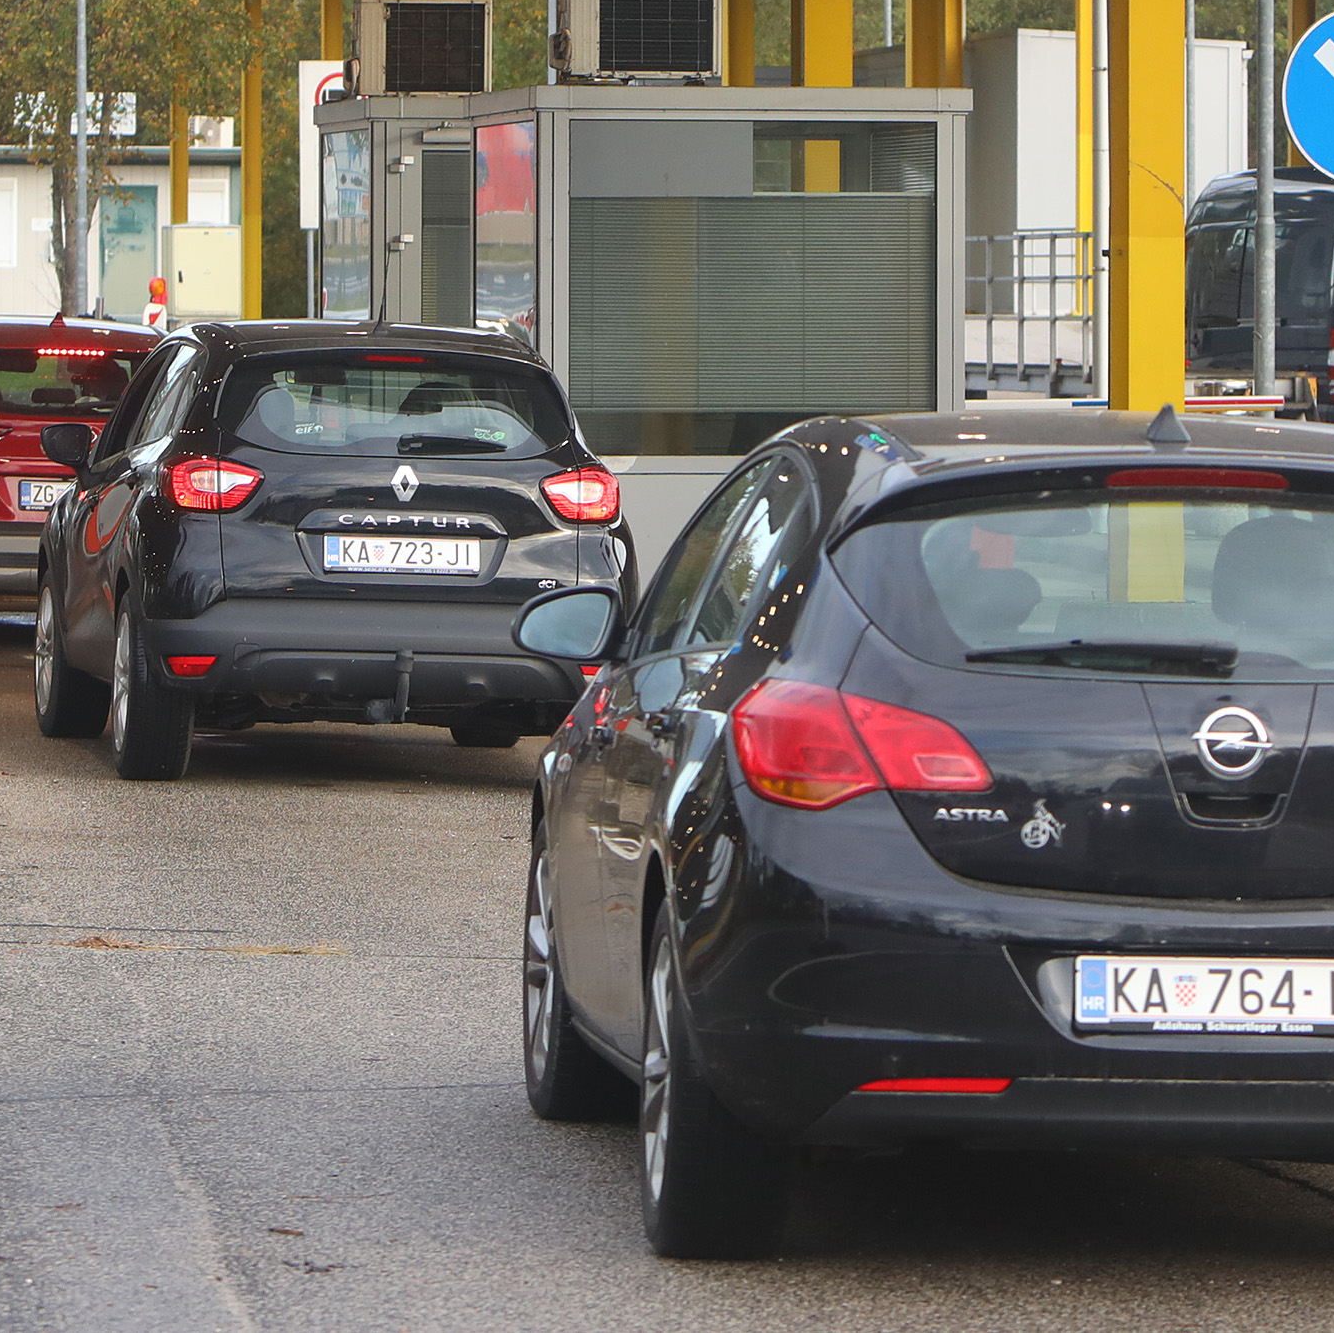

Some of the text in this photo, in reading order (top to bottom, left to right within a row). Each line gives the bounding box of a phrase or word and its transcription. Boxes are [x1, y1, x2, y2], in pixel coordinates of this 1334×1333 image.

[33, 484, 54, 503] ZG
[338, 514, 470, 529] CAPTUR
[327, 554, 339, 562] HR
[342, 540, 469, 566] KA 723-JI
[933, 807, 1010, 823] ASTRA
[1113, 968, 1168, 1014] KA
[1082, 996, 1105, 1010] HR
[1152, 1020, 1203, 1031] Autohaus
[1281, 1022, 1314, 1033] Essen
